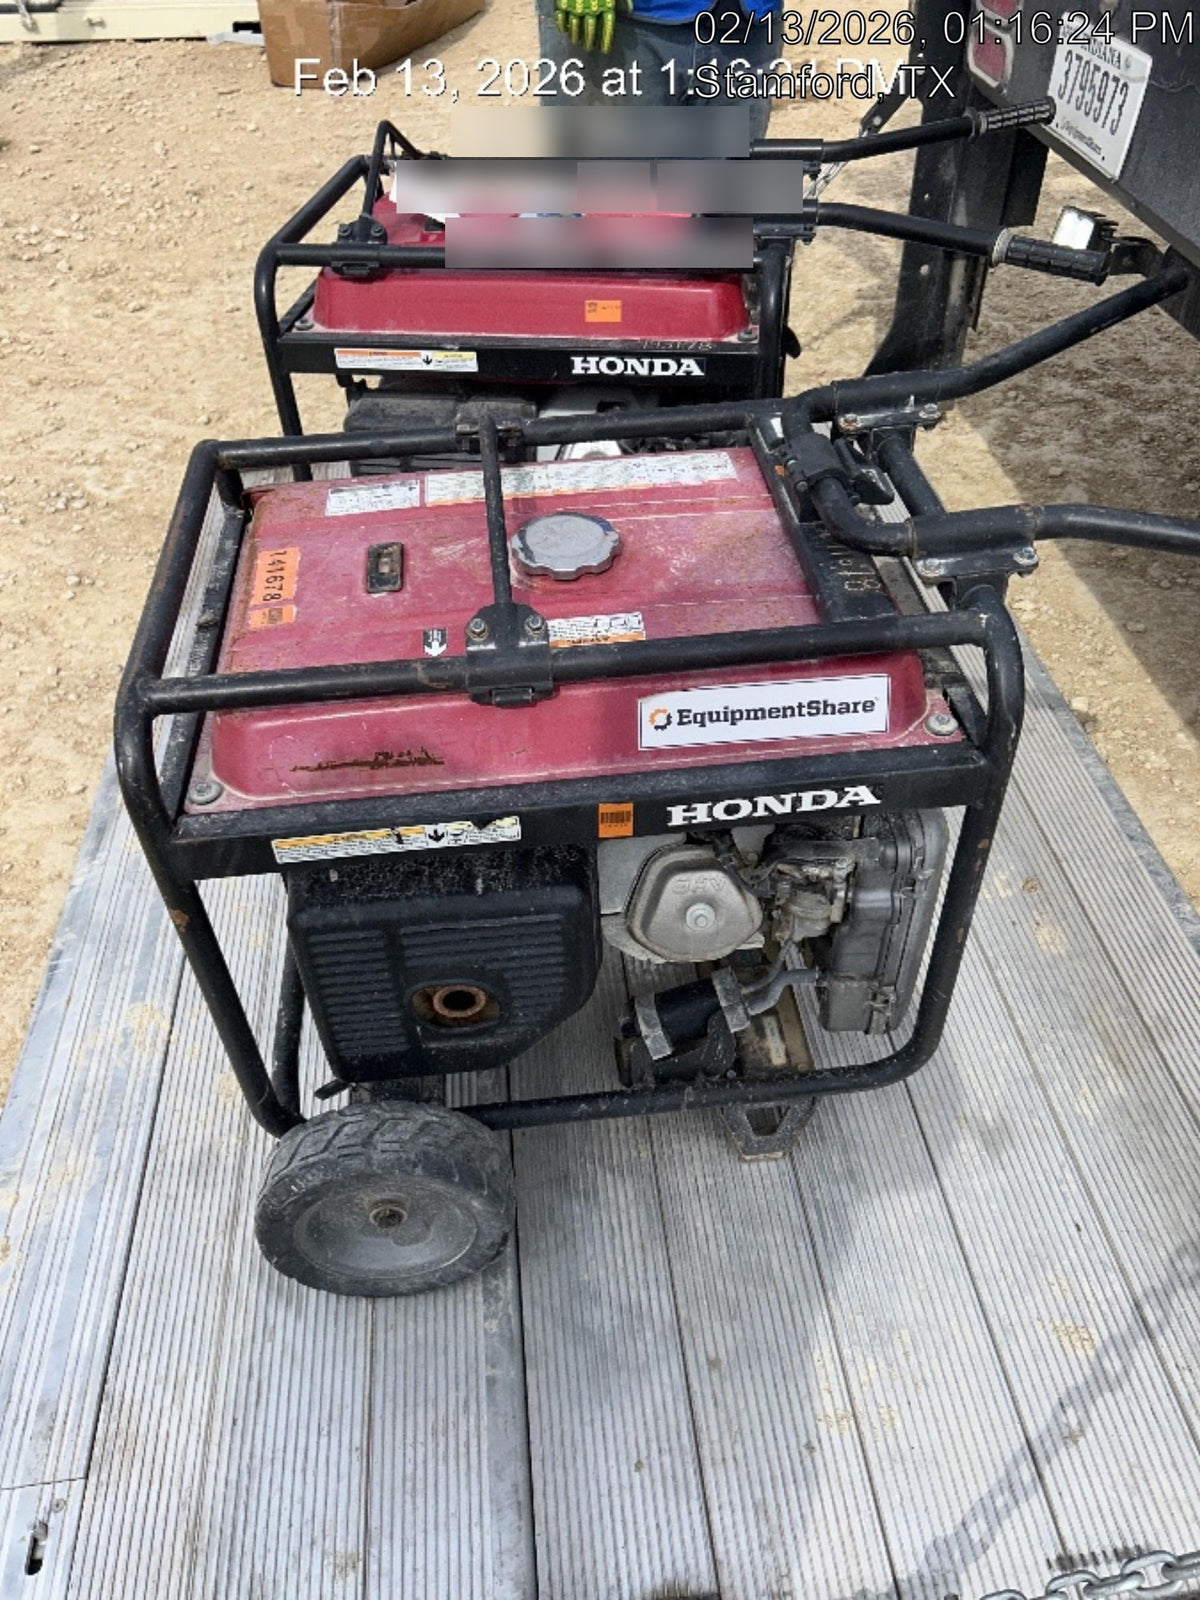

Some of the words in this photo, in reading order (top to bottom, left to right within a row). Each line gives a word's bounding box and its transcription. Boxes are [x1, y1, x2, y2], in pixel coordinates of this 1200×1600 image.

[1058, 49, 1129, 136] 3795973
[571, 356, 705, 376] HONDA
[262, 551, 287, 601] 141678
[676, 699, 876, 728] EquipmentShare
[666, 785, 881, 827] HONDA
